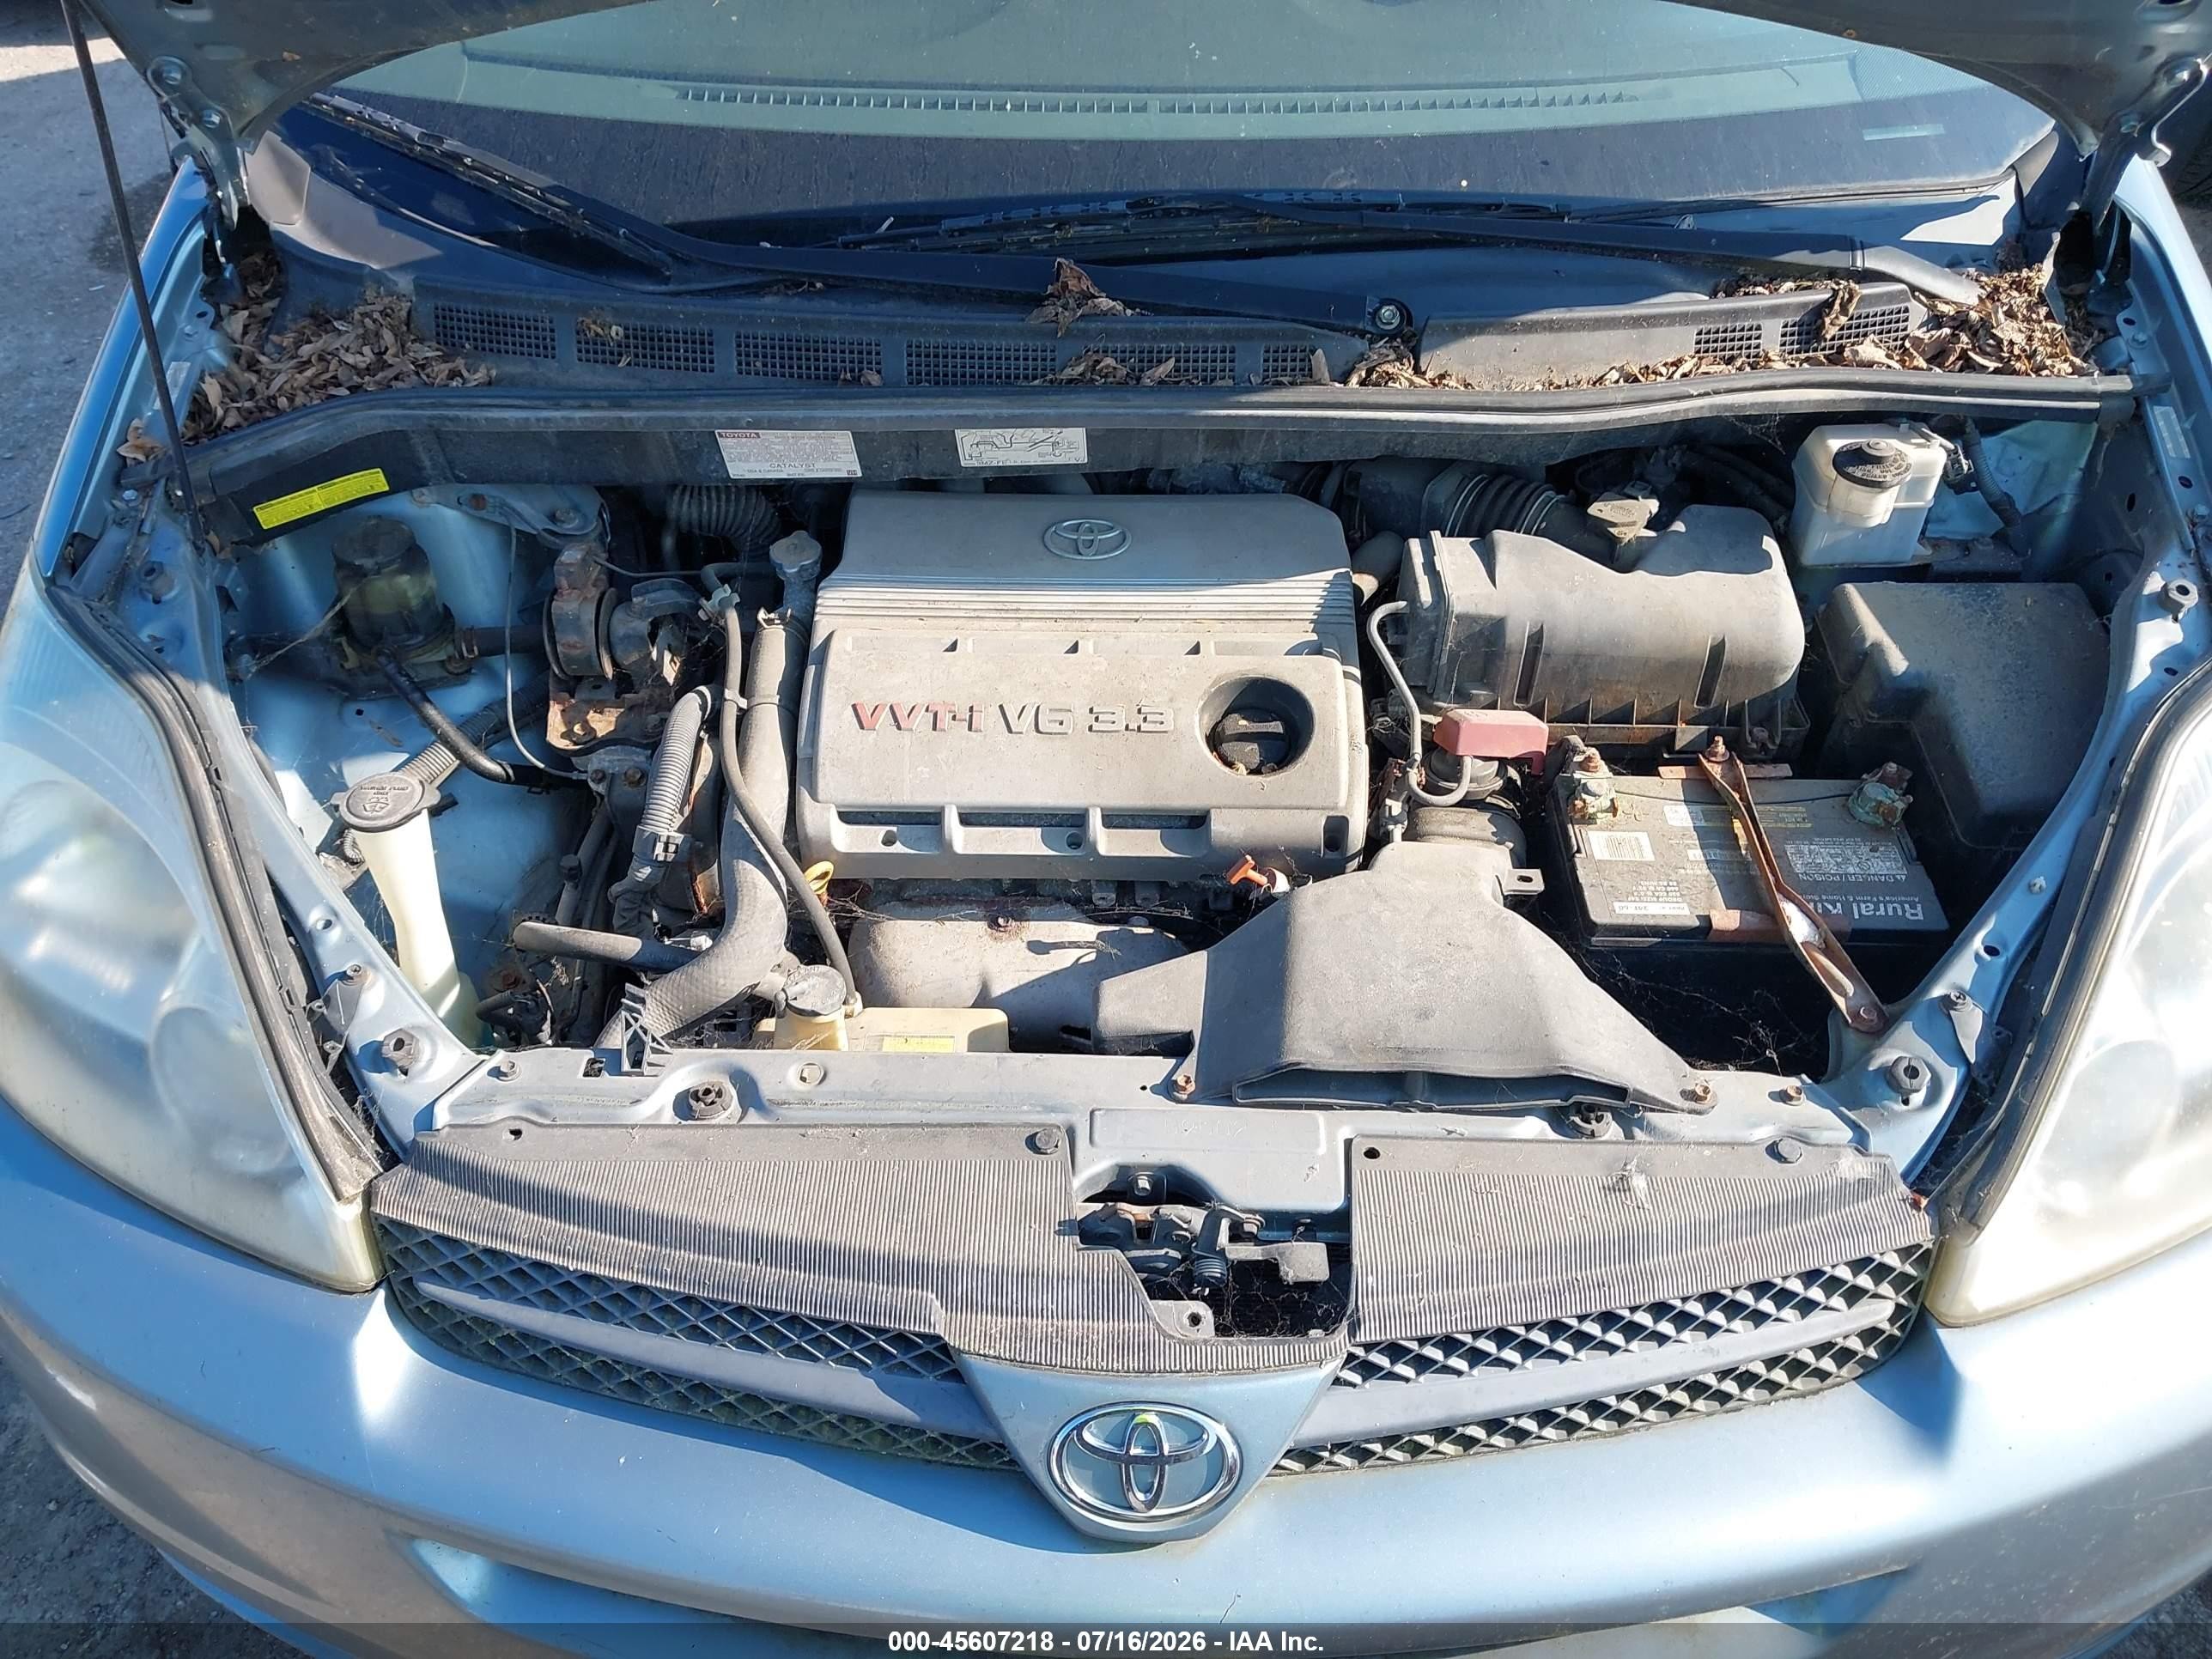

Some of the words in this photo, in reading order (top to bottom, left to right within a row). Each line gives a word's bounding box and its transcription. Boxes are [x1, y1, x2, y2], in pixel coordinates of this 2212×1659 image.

[997, 702, 1073, 735] V6
[1087, 701, 1176, 734] 3.3
[1798, 872, 1841, 882] POISON
[1852, 902, 1924, 921] Rural
